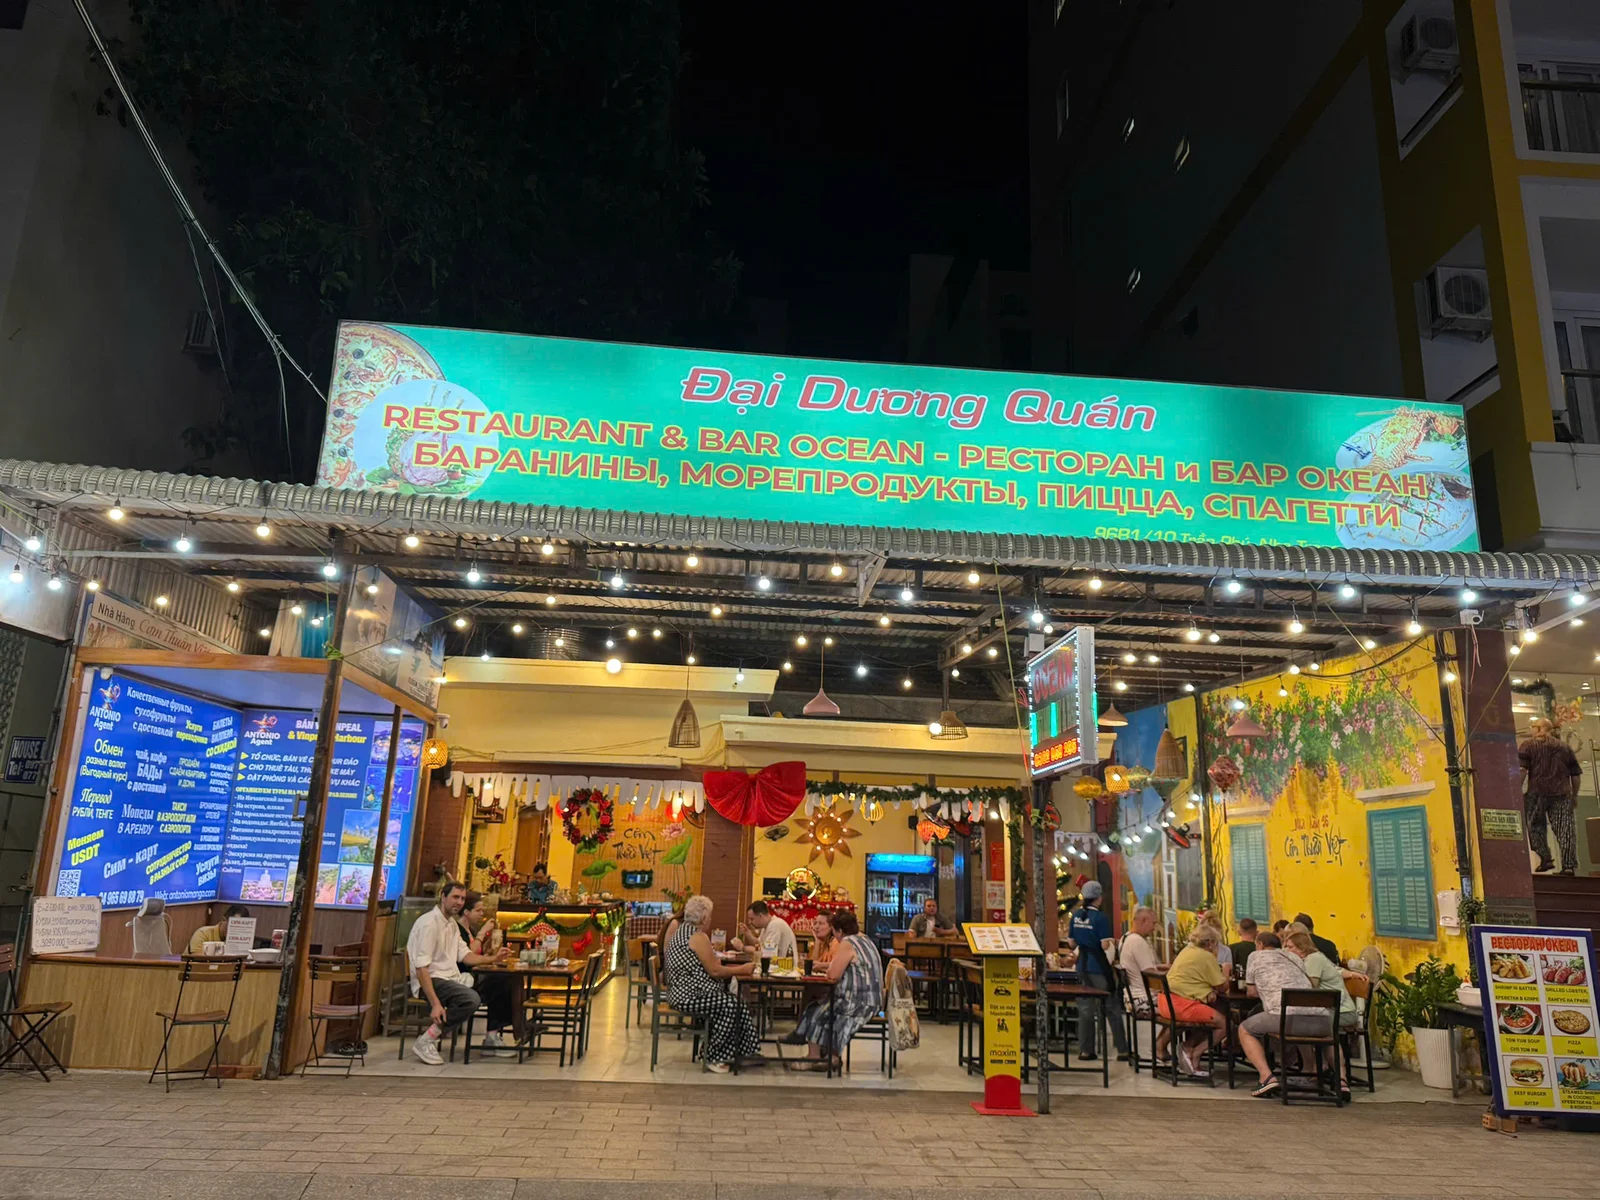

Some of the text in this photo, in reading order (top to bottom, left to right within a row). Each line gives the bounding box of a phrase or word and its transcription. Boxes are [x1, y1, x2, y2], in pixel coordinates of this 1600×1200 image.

[681, 366, 1157, 431] Đại Dương Quán
[383, 404, 653, 447] RESTAURANT
[660, 425, 688, 449] &
[698, 427, 780, 457] BAR
[789, 434, 924, 465] OCEAN
[958, 444, 1164, 480] РЕСТОРАН
[1175, 461, 1200, 482] и
[1210, 459, 1288, 487] БАР
[1296, 465, 1428, 498] ОКЕАН
[413, 441, 1401, 528] БАРАНИНЫ, МОРЕПРОДУКТЫ, ПИЦЦА, СПАГЕТТИ
[98, 602, 114, 619] Nhà
[115, 610, 135, 630] Hàng
[90, 706, 121, 722] ANTONIO
[94, 717, 114, 731] Agent
[244, 731, 281, 740] ANTONIO
[250, 738, 273, 746] Agent
[94, 738, 124, 757] Обмен
[121, 803, 154, 821] Мопеды
[67, 829, 104, 851] Меняем
[71, 843, 101, 867] USDT
[103, 858, 126, 879] Сим
[135, 843, 159, 864] карт
[1491, 936, 1579, 953] РЕСТОРАН ОКЕАН
